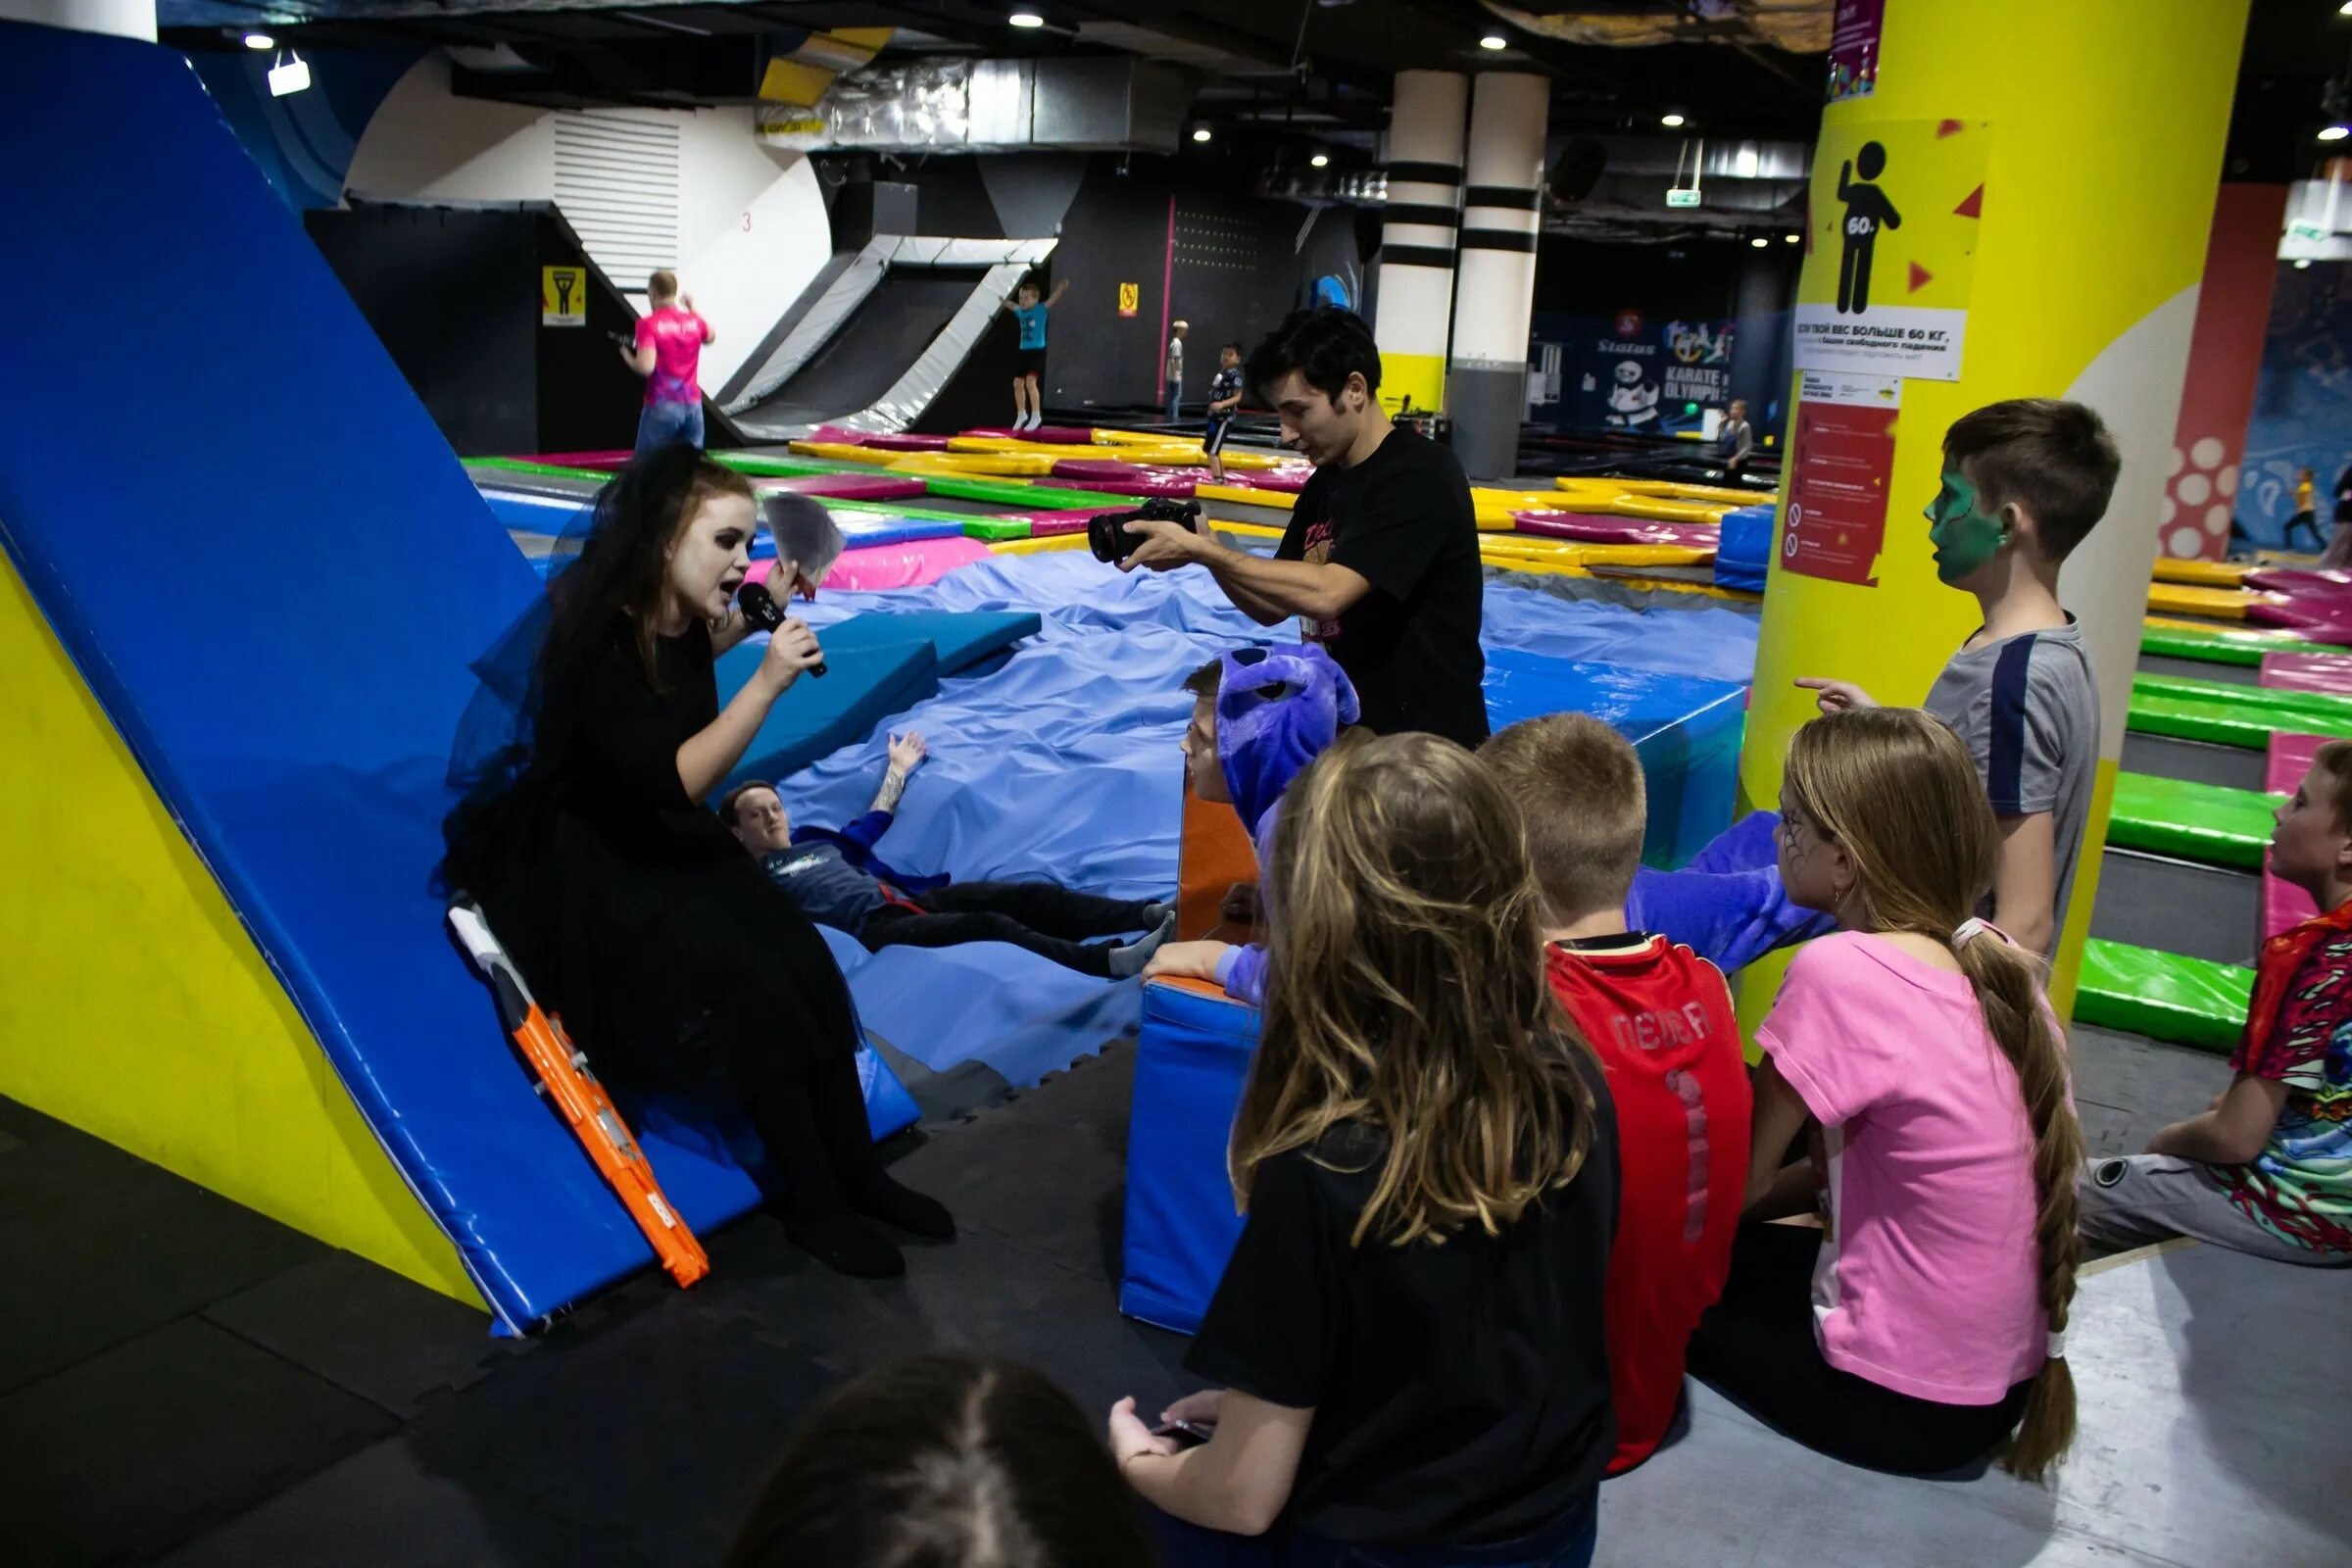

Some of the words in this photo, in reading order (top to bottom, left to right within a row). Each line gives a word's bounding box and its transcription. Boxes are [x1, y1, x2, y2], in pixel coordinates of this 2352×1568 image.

[742, 212, 752, 232] 3
[1833, 324, 1850, 335] ВЕС
[1853, 324, 1906, 339] БОЛЬШЕ
[1908, 328, 1926, 340] 60
[1845, 338, 1899, 350] свободного
[1900, 342, 1948, 353] падения
[1666, 366, 1721, 386] KARATE
